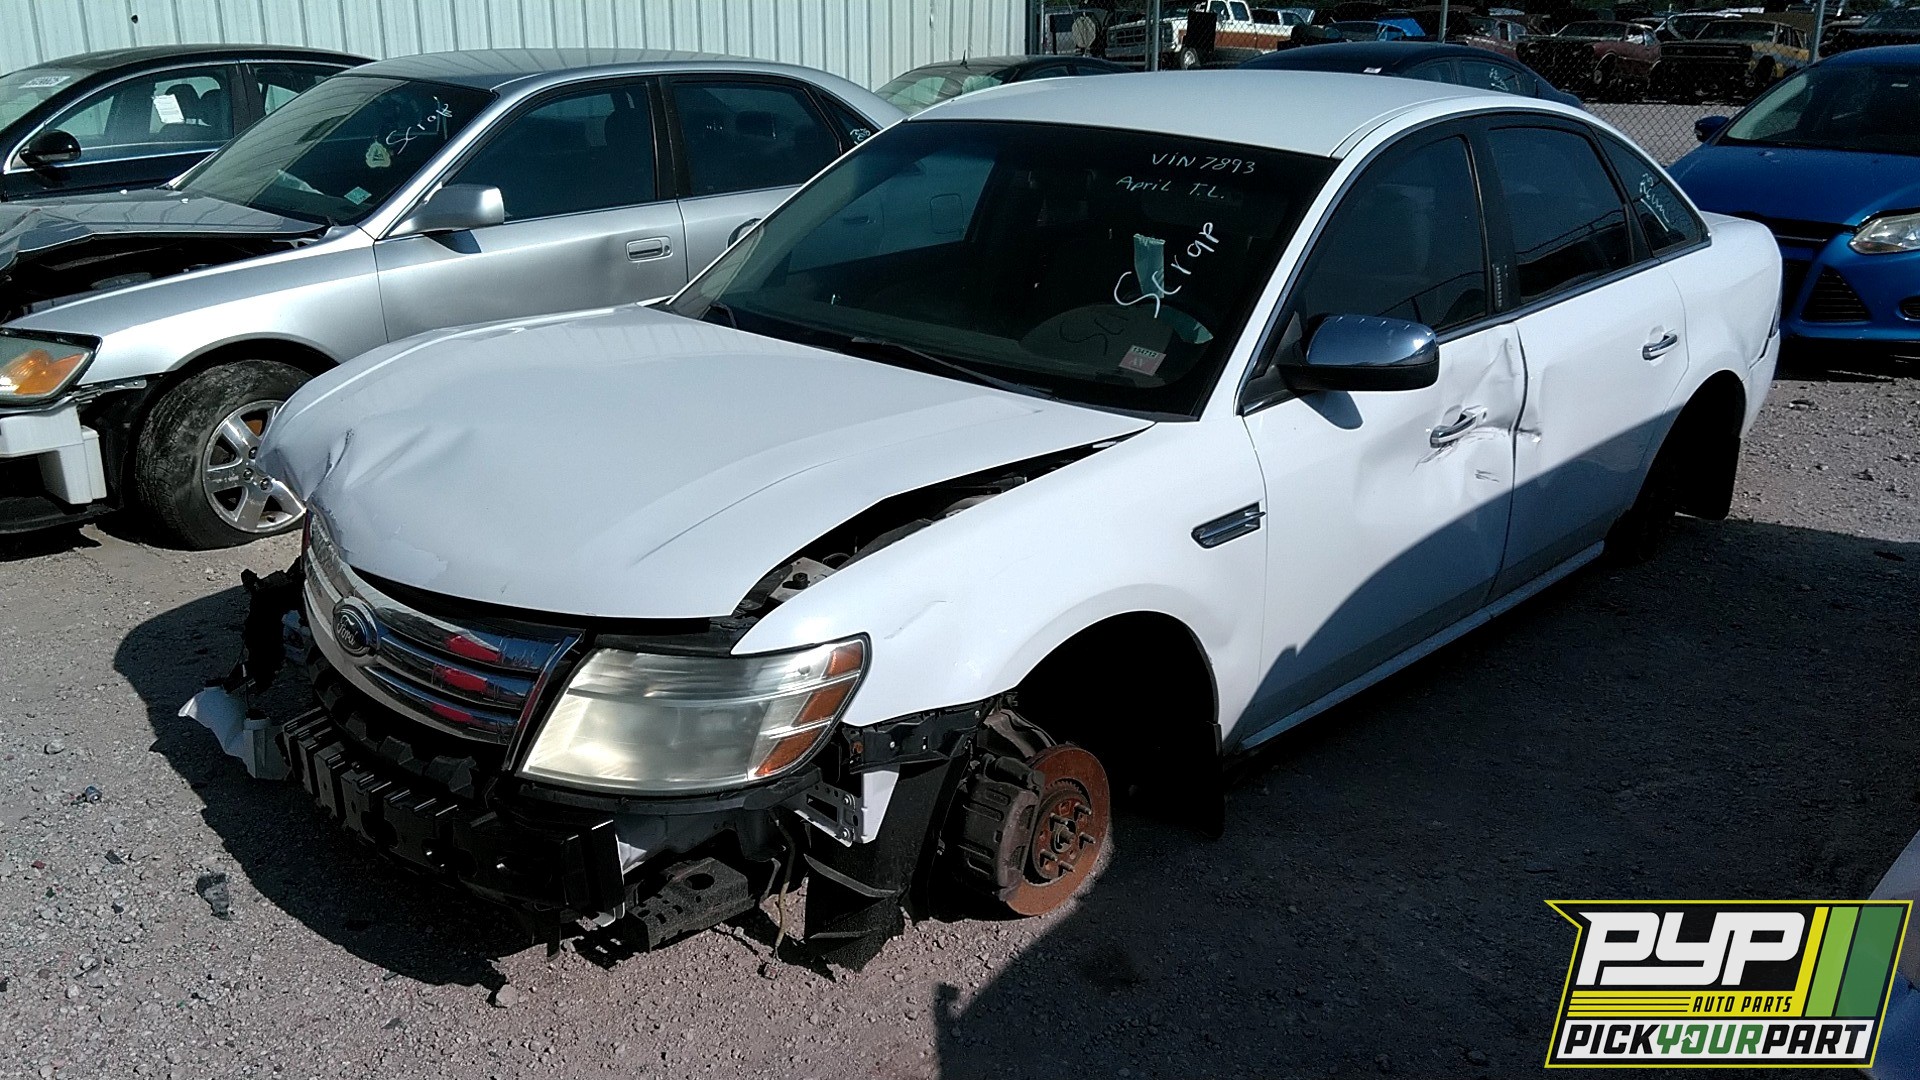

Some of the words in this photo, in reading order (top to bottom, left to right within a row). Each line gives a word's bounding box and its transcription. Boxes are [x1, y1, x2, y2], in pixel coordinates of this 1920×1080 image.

[1199, 156, 1256, 174] 7893
[1113, 221, 1220, 319] Scrap
[337, 614, 359, 646] Ford
